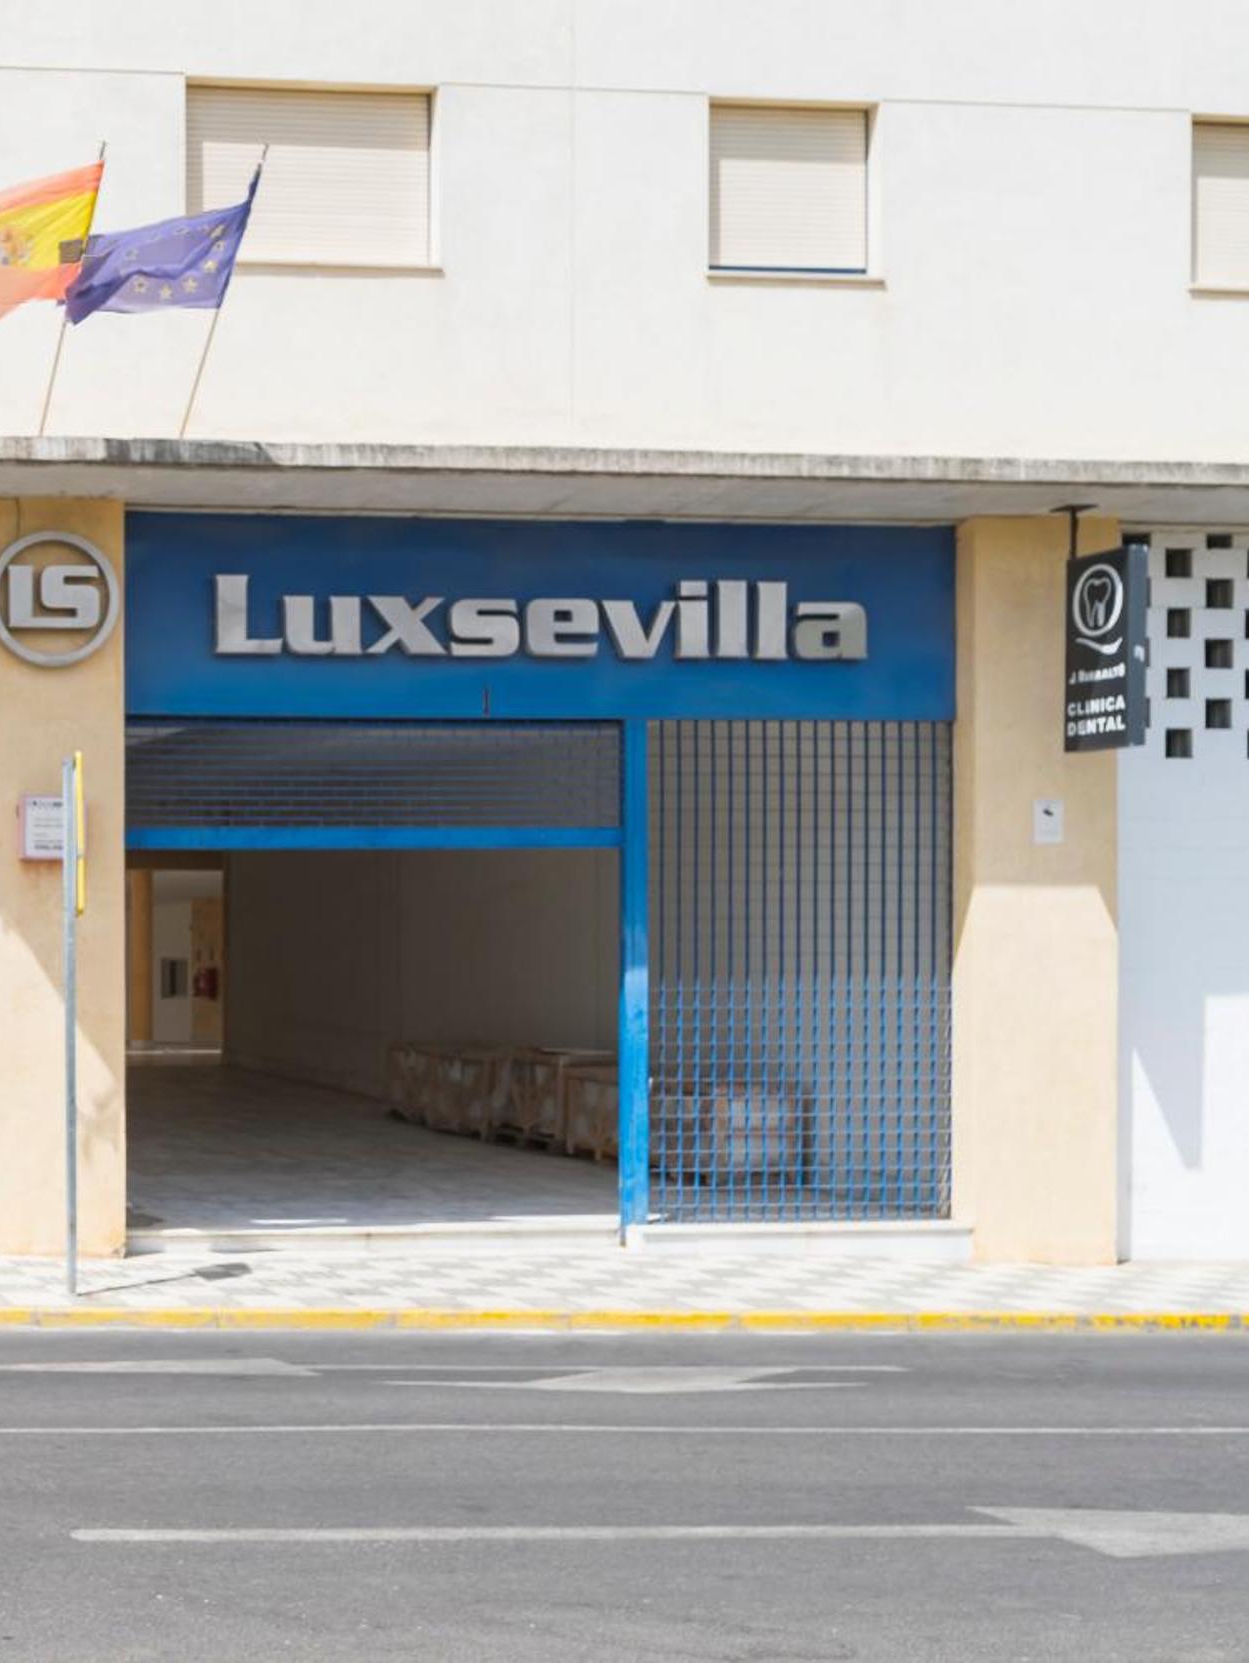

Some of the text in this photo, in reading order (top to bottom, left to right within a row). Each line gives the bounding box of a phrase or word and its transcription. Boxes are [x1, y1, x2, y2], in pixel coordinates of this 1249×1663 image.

[7, 564, 100, 629] LS
[215, 573, 868, 660] Luxsevilla
[1067, 715, 1126, 737] DENTAL
